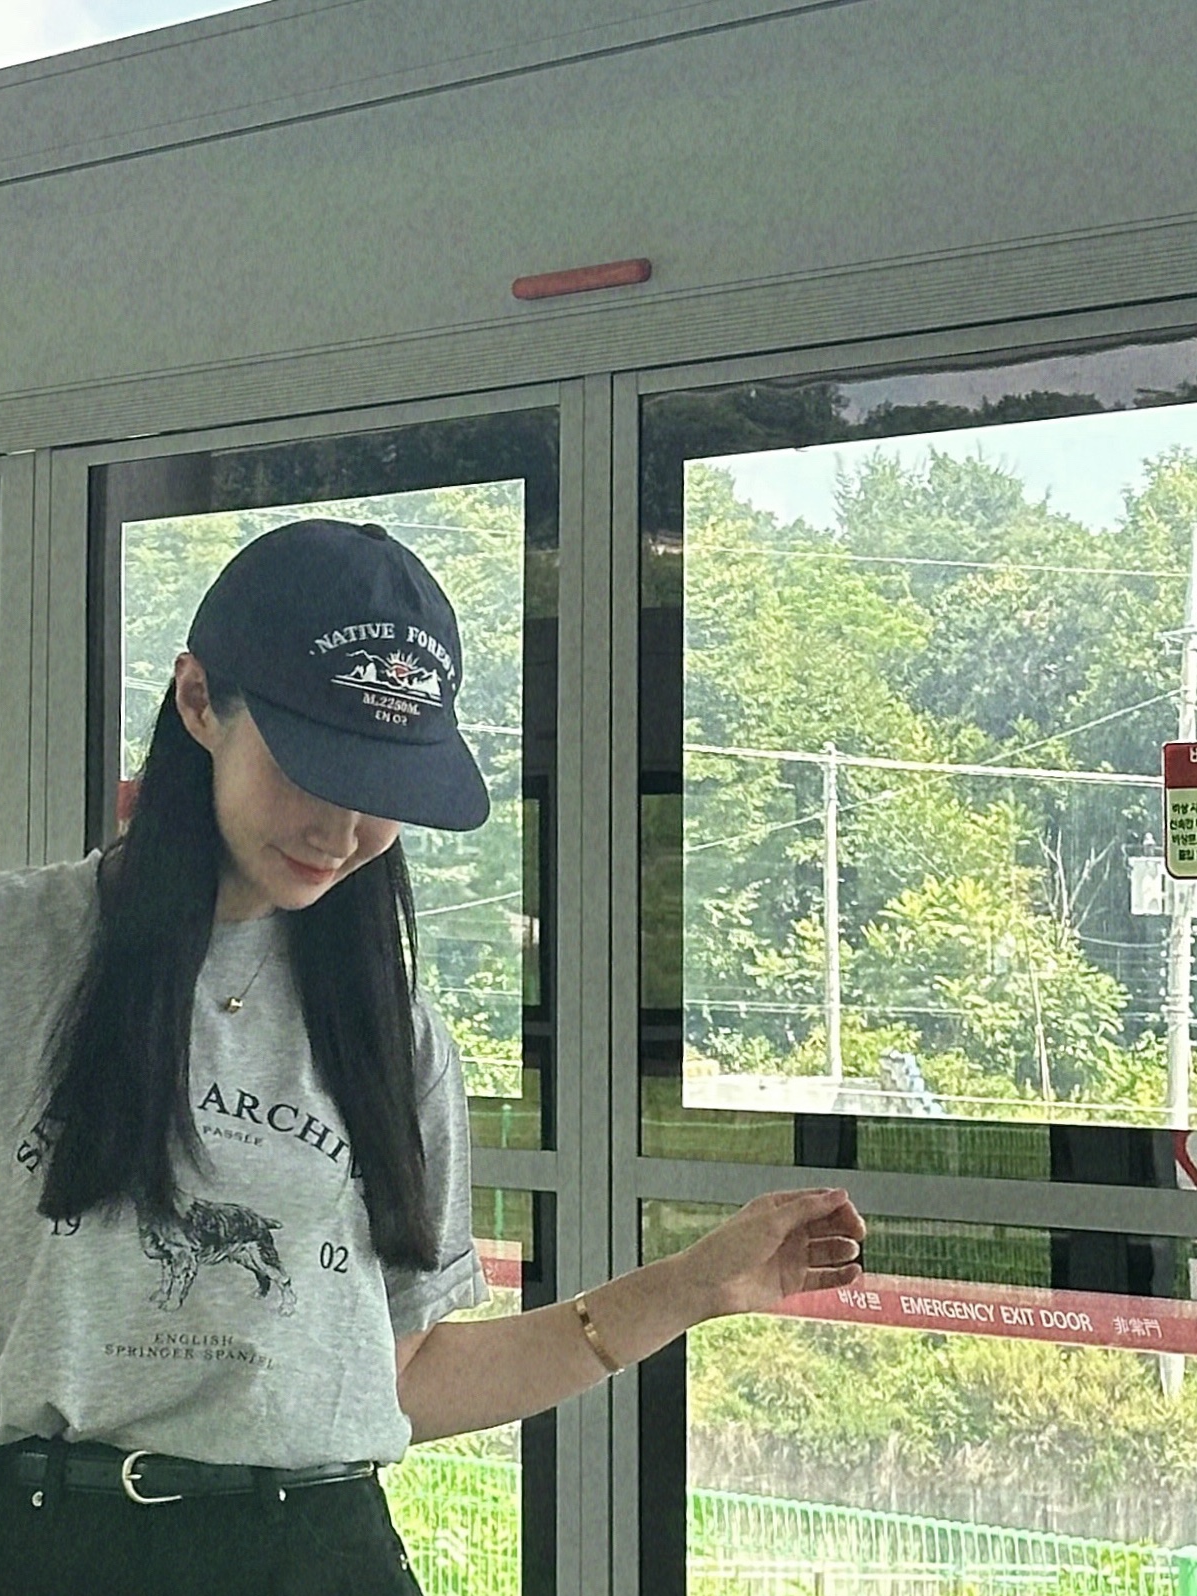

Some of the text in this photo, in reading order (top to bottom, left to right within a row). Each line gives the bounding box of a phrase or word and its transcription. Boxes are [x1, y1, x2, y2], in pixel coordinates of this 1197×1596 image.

[315, 622, 456, 680] NATIVE FOREST
[319, 1242, 349, 1274] 02
[837, 1288, 883, 1311] 비상문
[900, 1295, 1093, 1333] EMERGENCY EXIT DOOR
[154, 1332, 234, 1347] ENGLISH
[104, 1343, 276, 1371] SPRINGER SPANIEL
